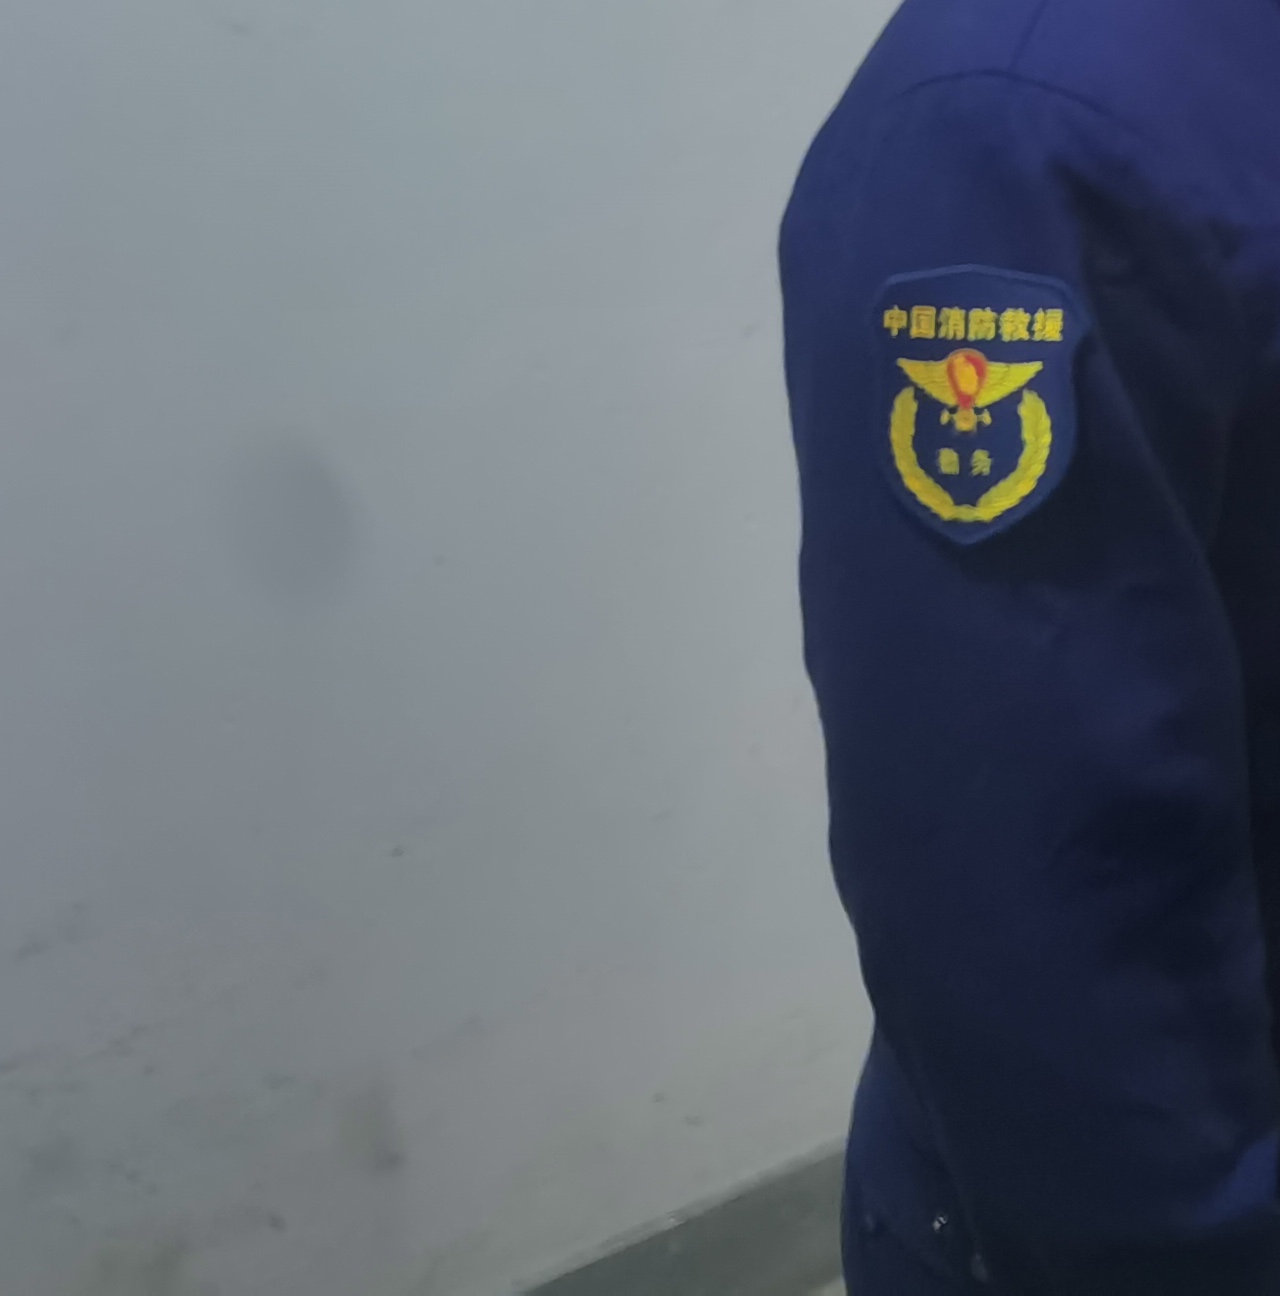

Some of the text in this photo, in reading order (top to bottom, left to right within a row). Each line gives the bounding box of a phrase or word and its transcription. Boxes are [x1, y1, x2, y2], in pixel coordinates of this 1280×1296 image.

[882, 304, 1064, 342] 中国消防救援
